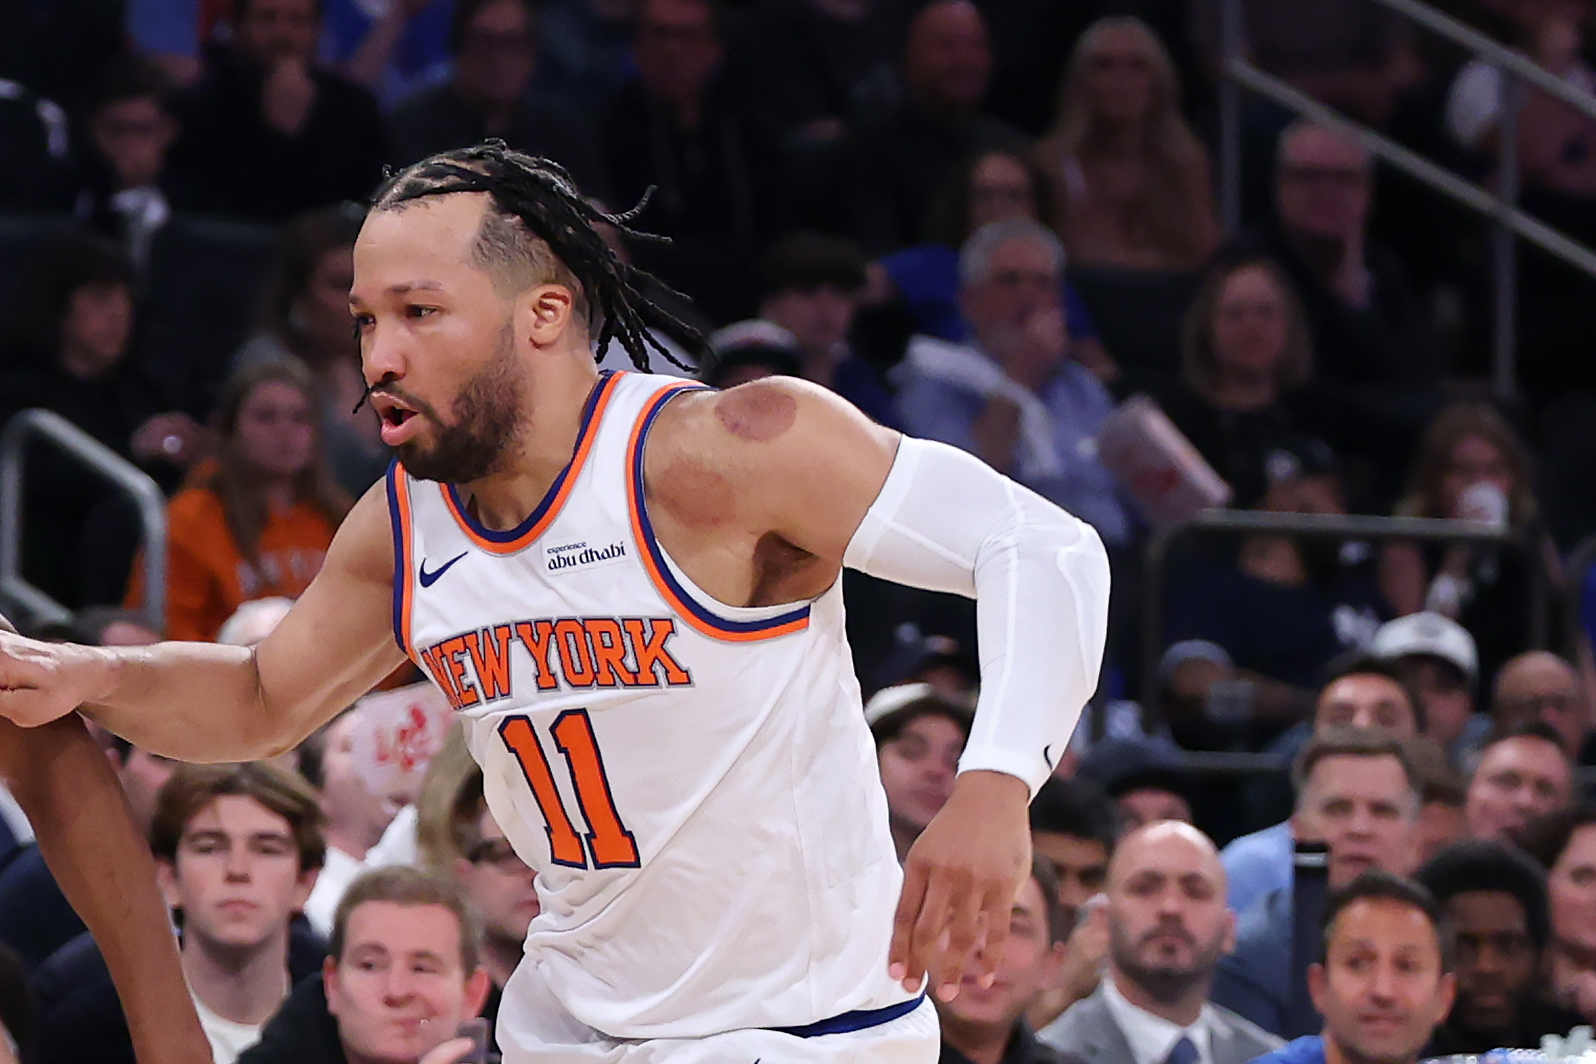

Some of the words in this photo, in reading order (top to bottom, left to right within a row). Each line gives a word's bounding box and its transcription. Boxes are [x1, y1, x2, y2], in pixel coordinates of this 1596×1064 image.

[546, 541, 587, 554] experience
[547, 554, 577, 570] abu
[578, 540, 626, 565] dhabi
[420, 622, 514, 711] NEW
[514, 615, 696, 692] YORK
[497, 707, 641, 870] 11
